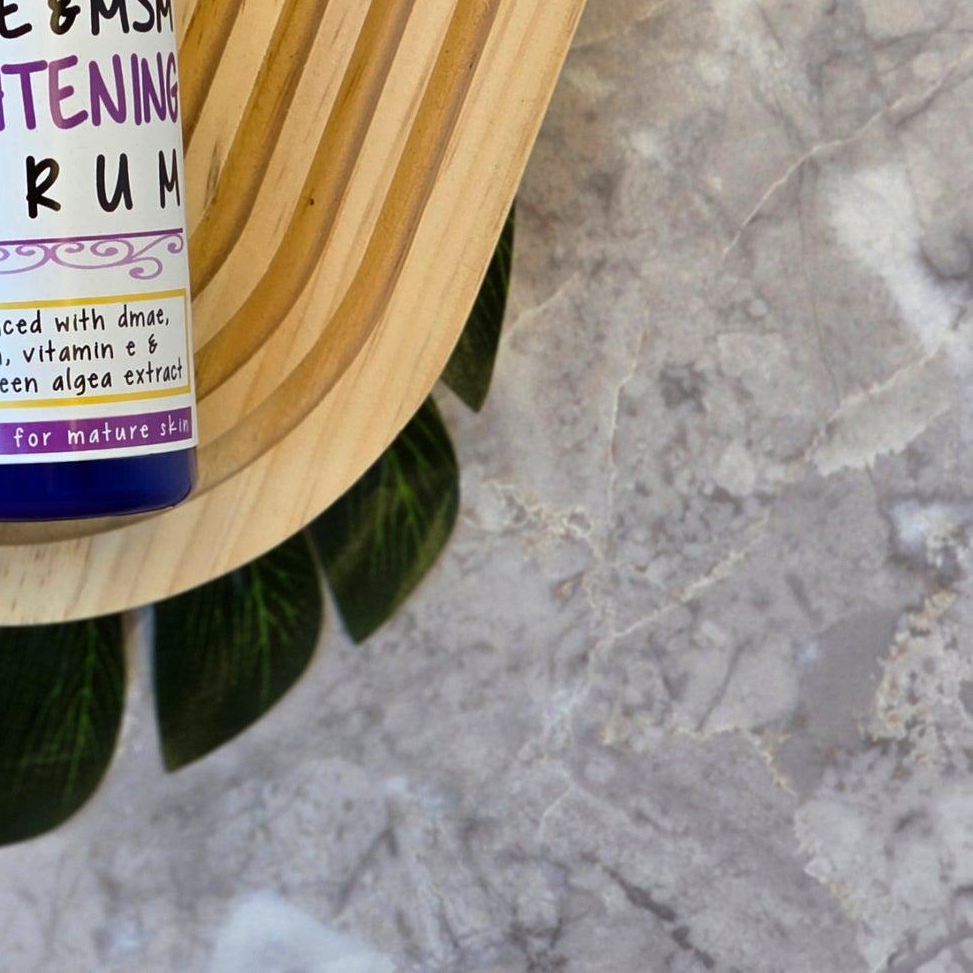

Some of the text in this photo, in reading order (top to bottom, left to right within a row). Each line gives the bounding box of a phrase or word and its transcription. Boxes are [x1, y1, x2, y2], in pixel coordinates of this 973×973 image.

[55, 308, 105, 333] with
[118, 304, 169, 328] dmae,
[23, 339, 114, 364] vitamin
[126, 340, 136, 356] e
[148, 334, 158, 355] &
[52, 367, 112, 396] algea
[124, 358, 182, 386] extract
[14, 427, 51, 448] for
[68, 421, 149, 446] mature
[160, 415, 189, 437] skin
